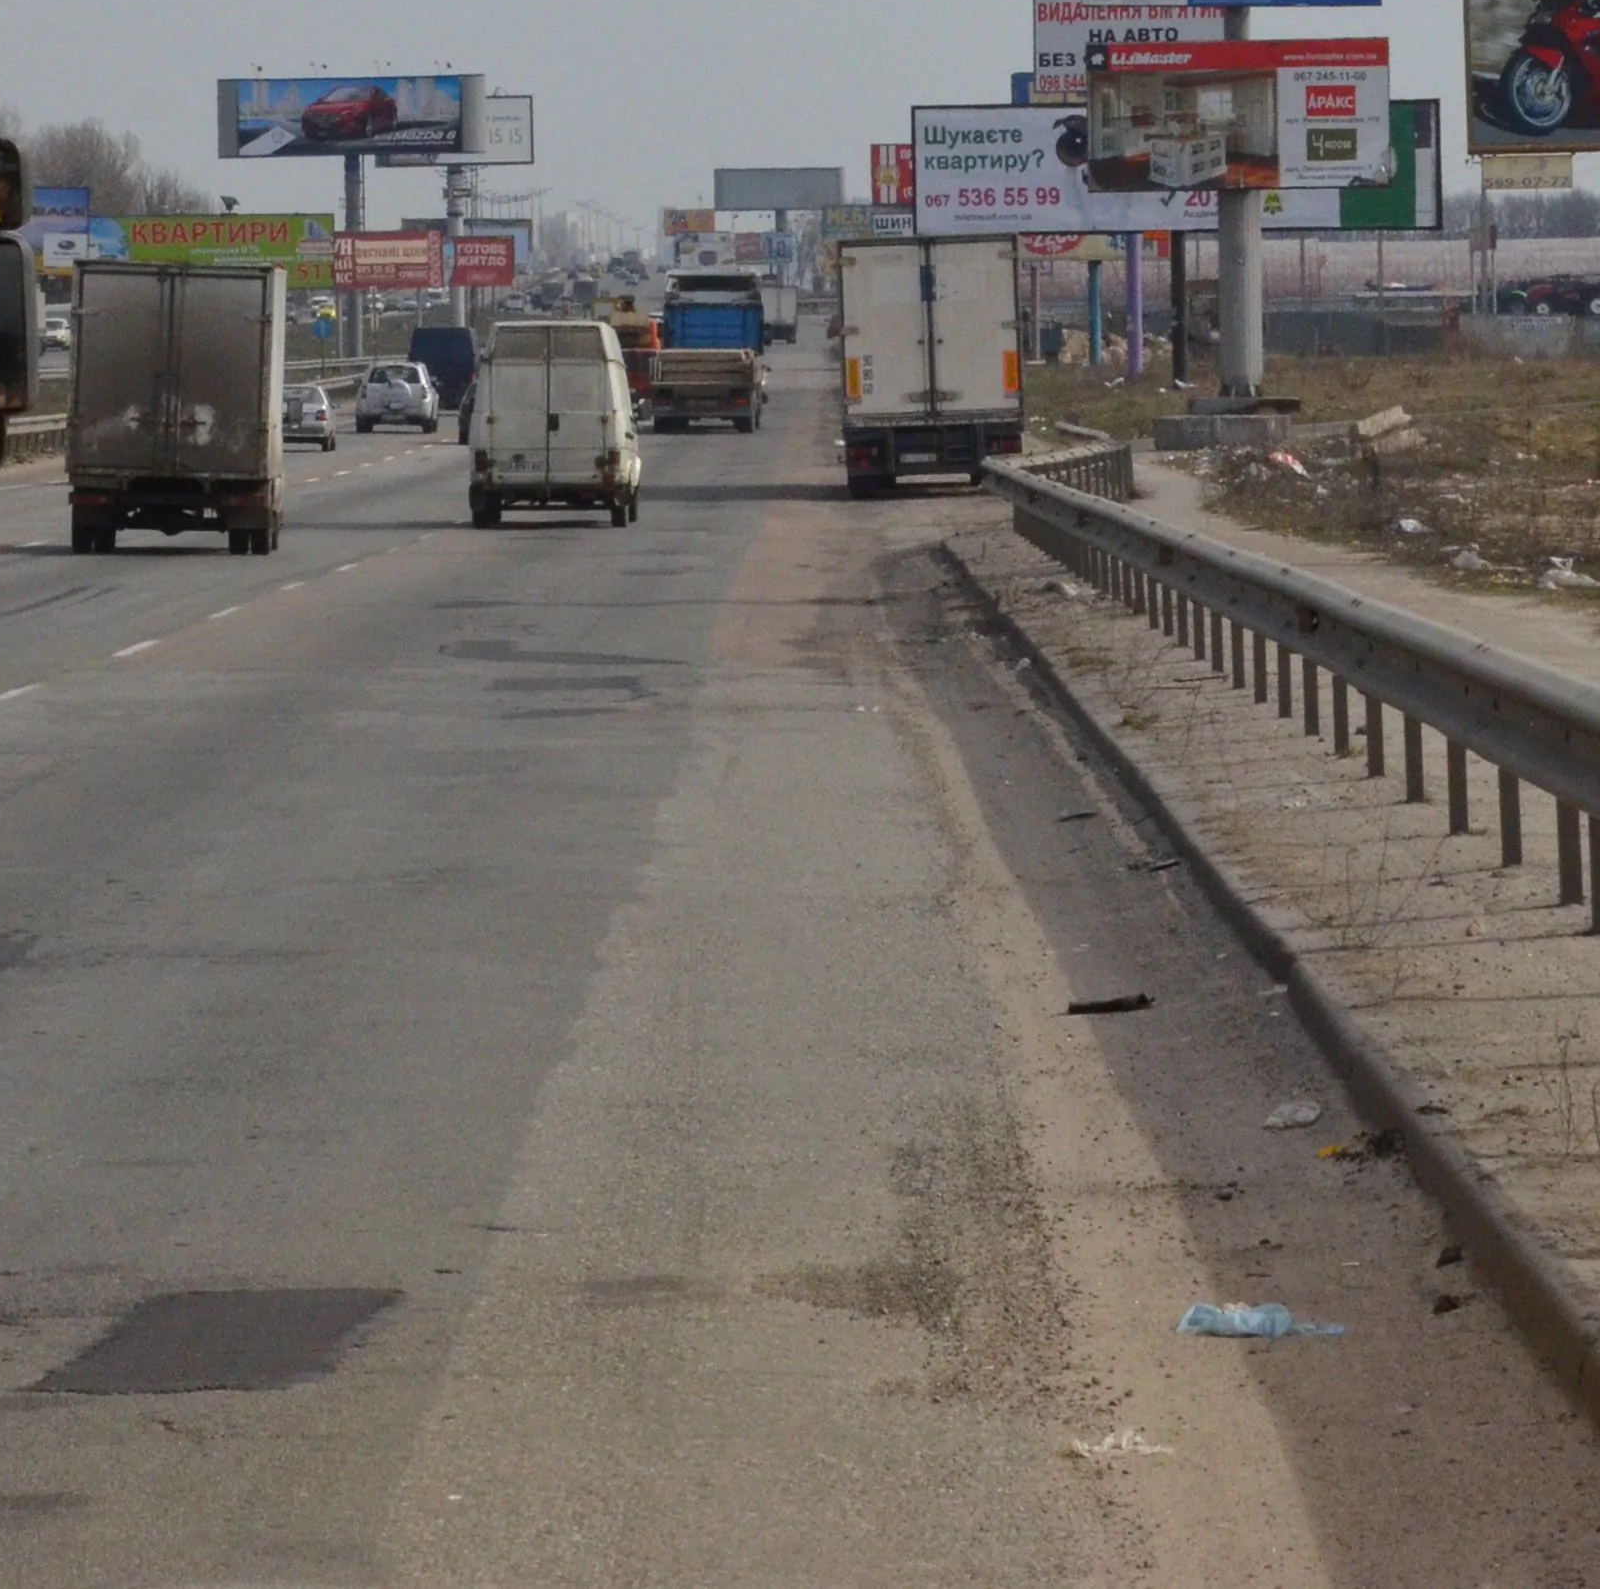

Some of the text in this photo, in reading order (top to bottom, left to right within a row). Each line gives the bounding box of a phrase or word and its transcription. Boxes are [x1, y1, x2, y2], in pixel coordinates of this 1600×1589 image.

[1037, 2, 1142, 24] ВИДАЛЕННЯ
[1089, 27, 1179, 43] НА АВТО
[1038, 52, 1076, 68] БЕЗ
[923, 125, 1023, 149] Шукаєте
[923, 149, 1045, 174] квартиру?
[924, 186, 1061, 208] 067 536 55 99
[131, 220, 288, 245] КВАРТИРИ
[456, 243, 507, 255] ГОТОВЕ
[456, 256, 507, 268] ЖИТЛО
